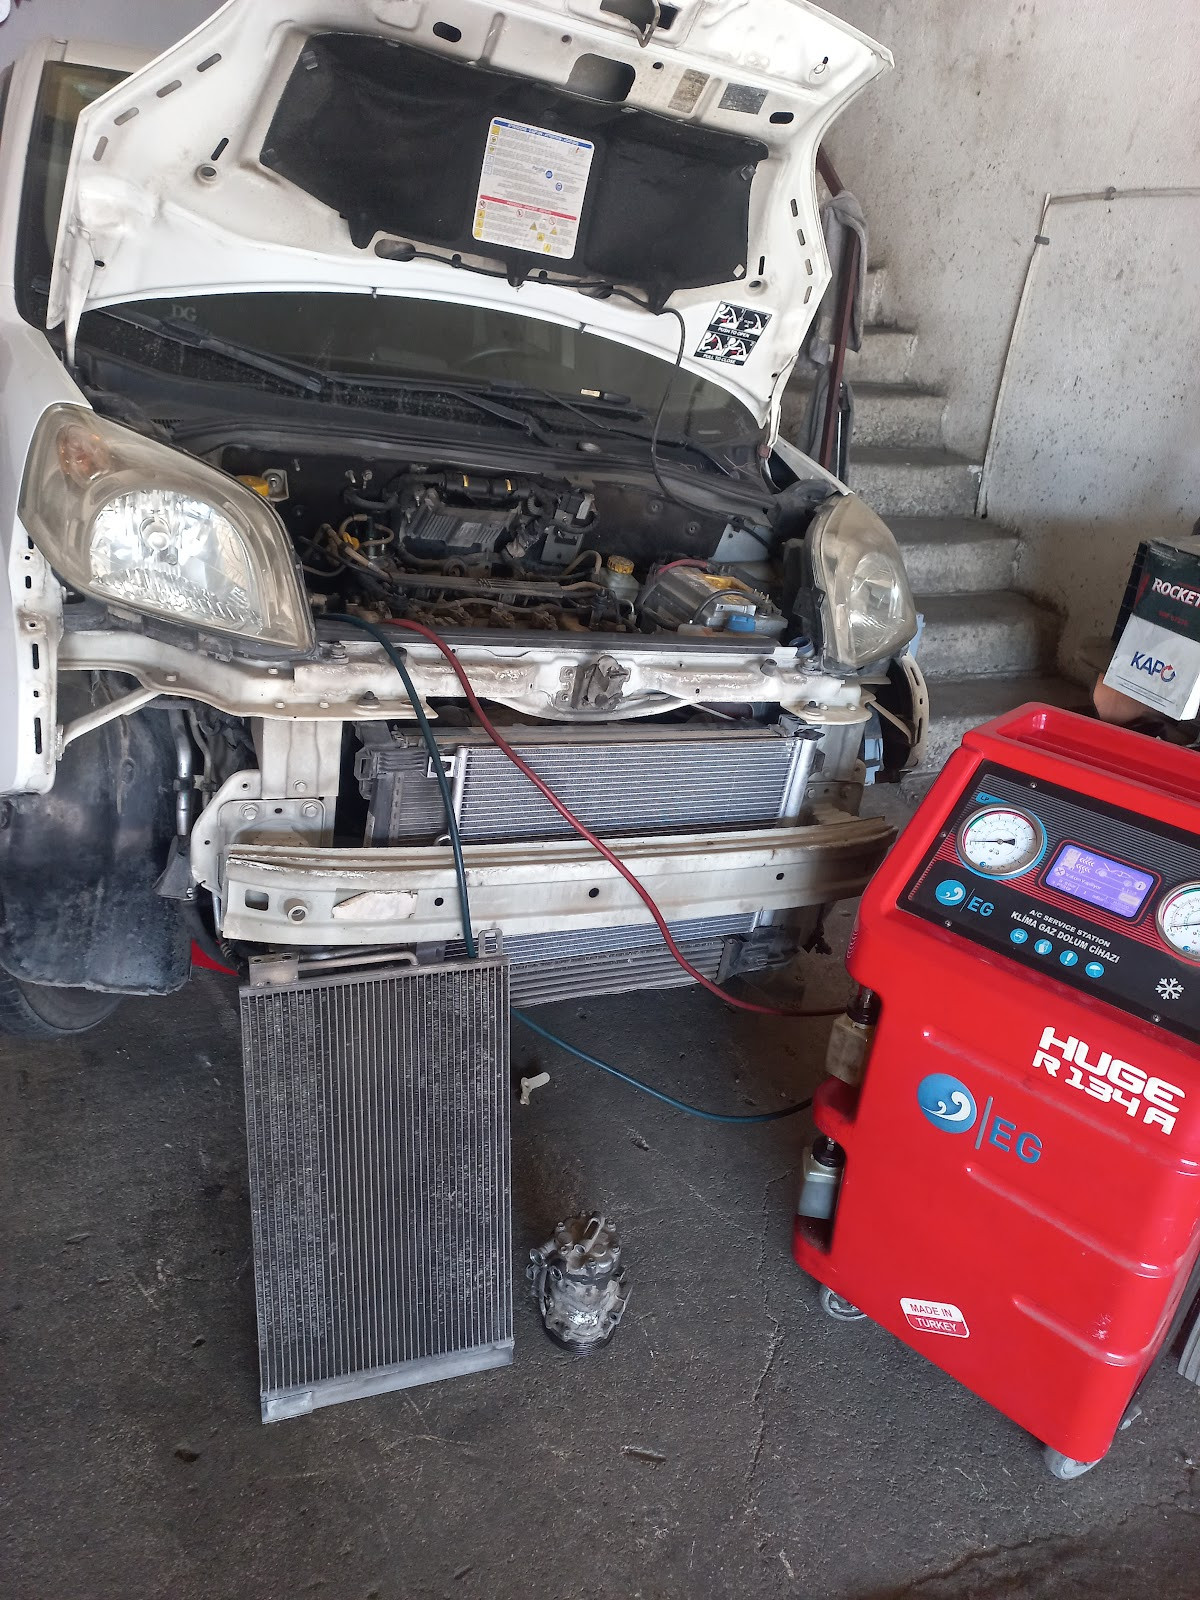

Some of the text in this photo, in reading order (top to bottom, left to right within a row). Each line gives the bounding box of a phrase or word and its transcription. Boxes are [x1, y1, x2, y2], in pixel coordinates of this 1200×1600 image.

[1151, 577, 1200, 607] ROCKET
[967, 895, 995, 917] EG
[1010, 910, 1121, 964] KLİMA GAZ DOLUM CİHAZI
[1029, 909, 1111, 948] A/C SERVICE STATION
[1039, 1026, 1186, 1113] HUGE
[1032, 1050, 1176, 1135] R 134 A
[988, 1114, 1043, 1164] EG
[909, 1303, 952, 1318] MADE IN
[914, 1317, 957, 1332] TURKEY
